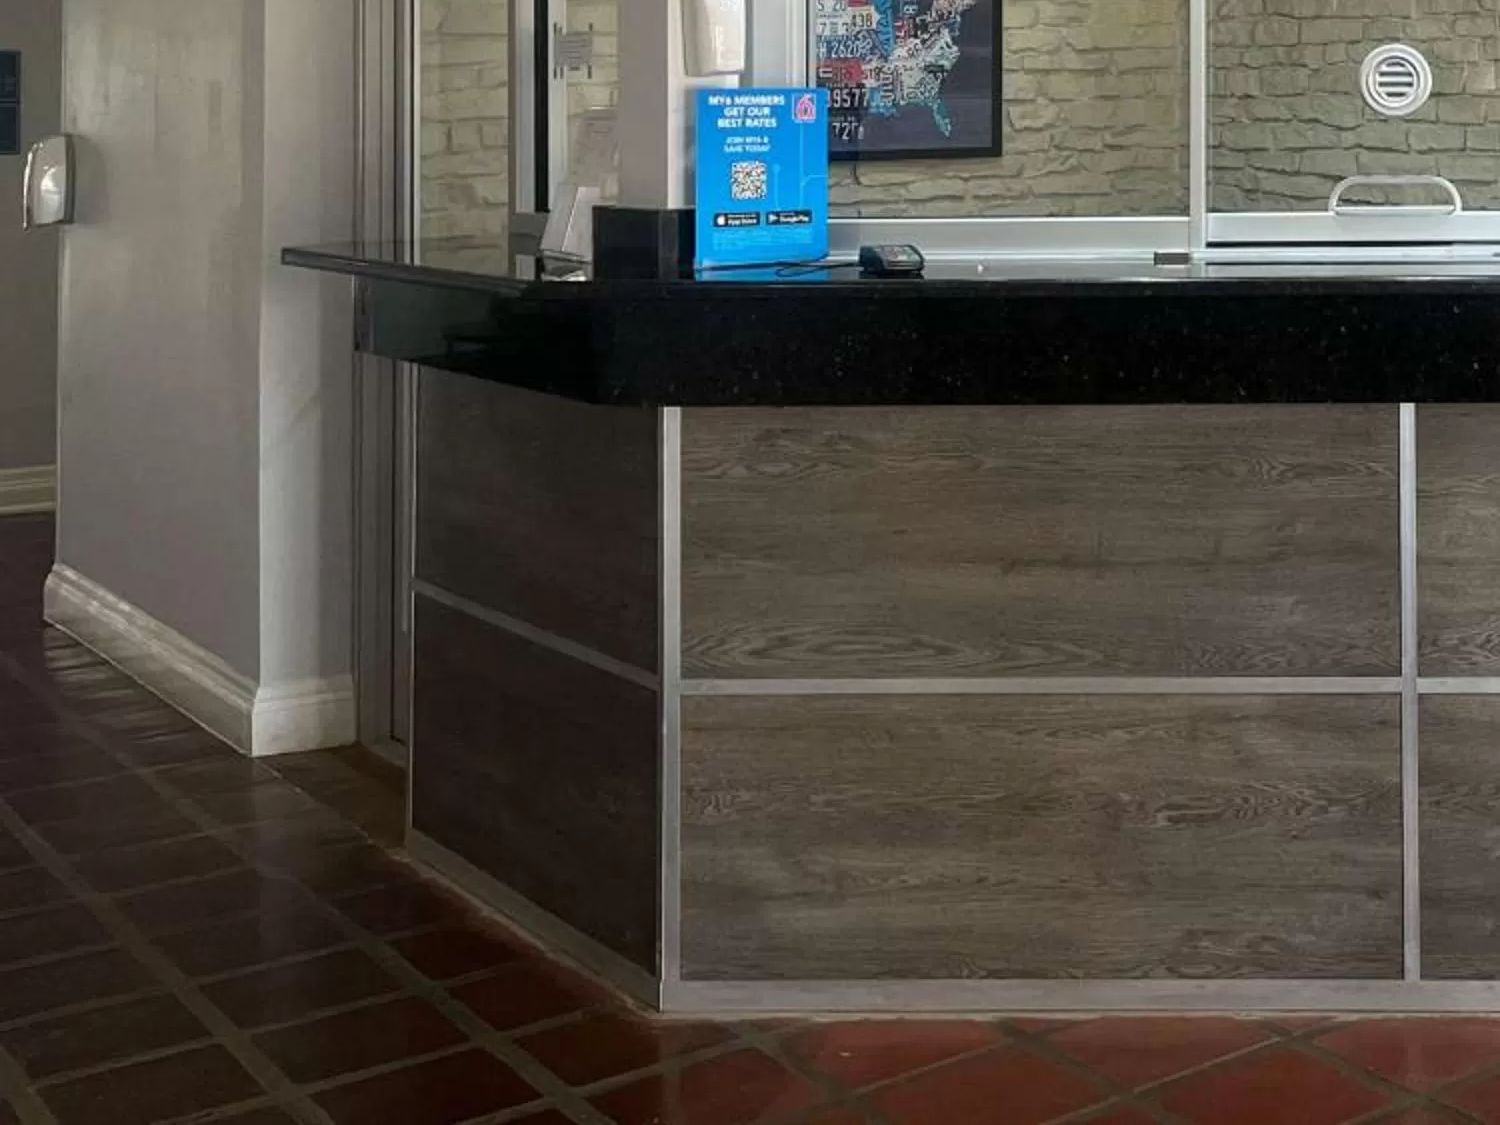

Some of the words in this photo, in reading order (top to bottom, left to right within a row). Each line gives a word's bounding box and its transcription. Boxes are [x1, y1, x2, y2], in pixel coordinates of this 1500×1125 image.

[733, 95, 785, 106] MEMBERS
[724, 106, 744, 116] GET
[747, 106, 771, 116] OUR
[718, 117, 743, 128] BEST
[745, 117, 777, 128] RATES
